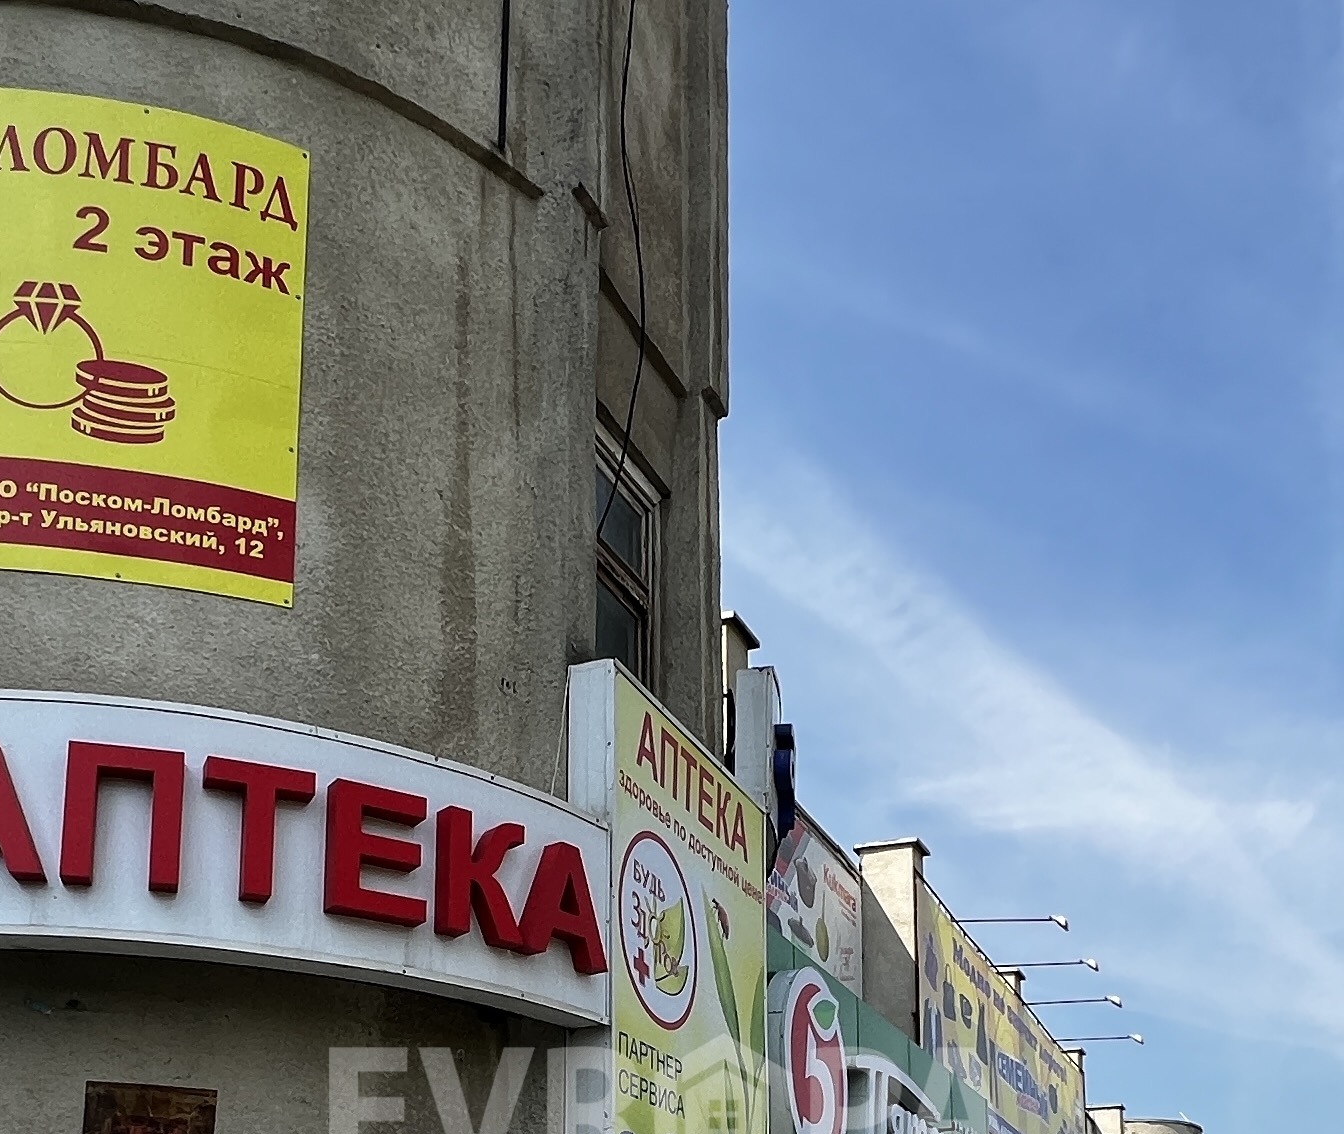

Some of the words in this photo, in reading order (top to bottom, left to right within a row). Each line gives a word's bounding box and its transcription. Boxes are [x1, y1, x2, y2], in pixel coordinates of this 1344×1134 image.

[72, 206, 110, 253] 2
[134, 226, 291, 296] этаж
[40, 510, 225, 555] Ульяновский,
[234, 537, 264, 559] 12
[636, 711, 748, 864] АПТЕКА
[619, 769, 671, 829] здоровье
[674, 819, 686, 841] по
[688, 833, 740, 888] доступной
[633, 858, 665, 902] БУДЬ
[618, 1031, 683, 1082] ПАРТНЕР
[618, 1069, 685, 1119] СЕРВИСА
